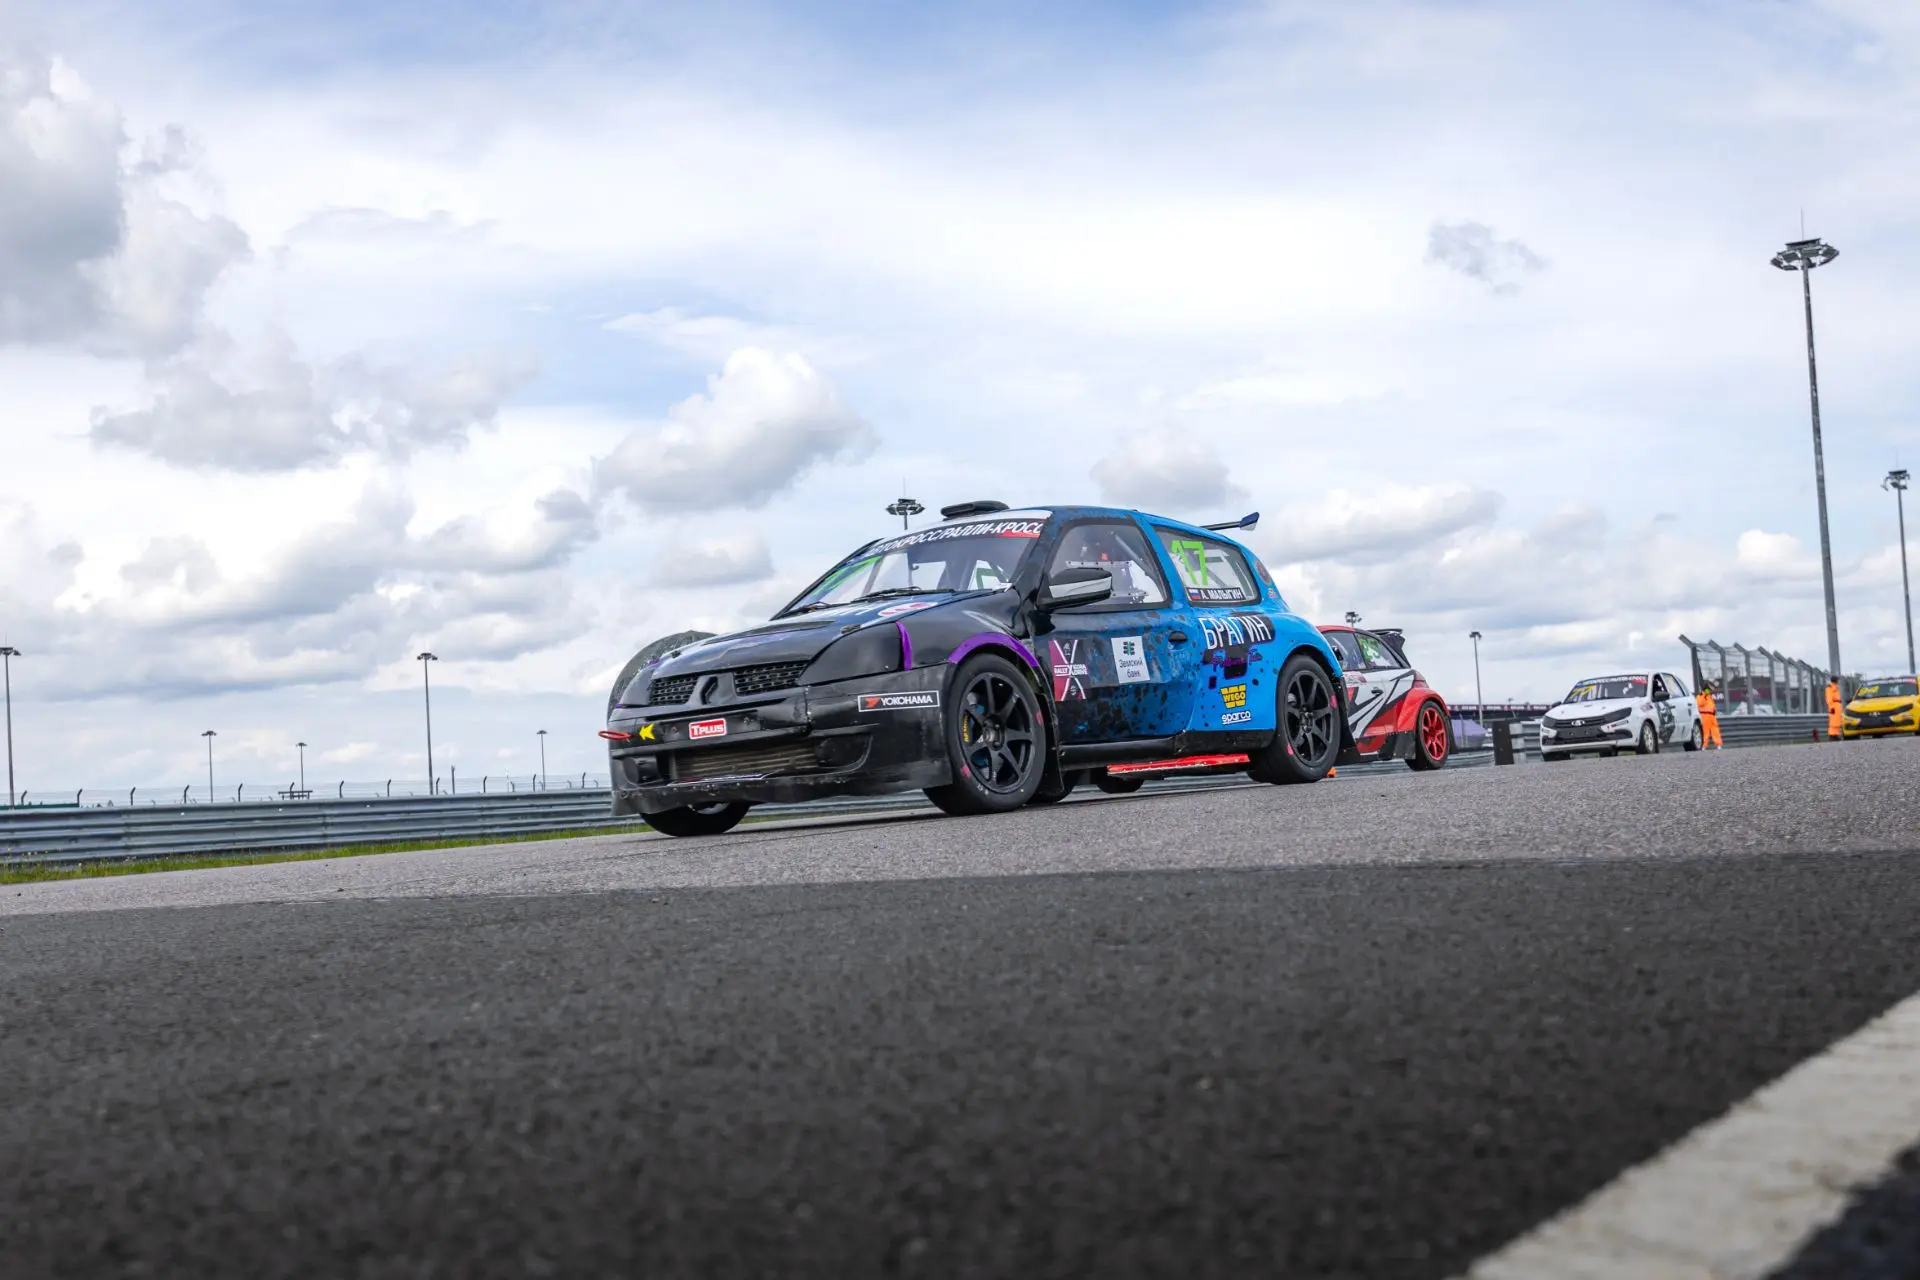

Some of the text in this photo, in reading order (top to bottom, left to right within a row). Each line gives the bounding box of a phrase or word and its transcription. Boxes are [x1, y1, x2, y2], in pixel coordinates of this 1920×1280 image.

[1171, 540, 1208, 586] 17
[1208, 589, 1243, 600] МАЛЫГИН
[1198, 615, 1271, 650] БРАГИН
[1119, 657, 1143, 668] Земский
[1126, 668, 1141, 678] банк
[881, 695, 933, 706] YOKOHAMA
[1223, 691, 1246, 702] WEGO
[1221, 711, 1251, 723] sparco
